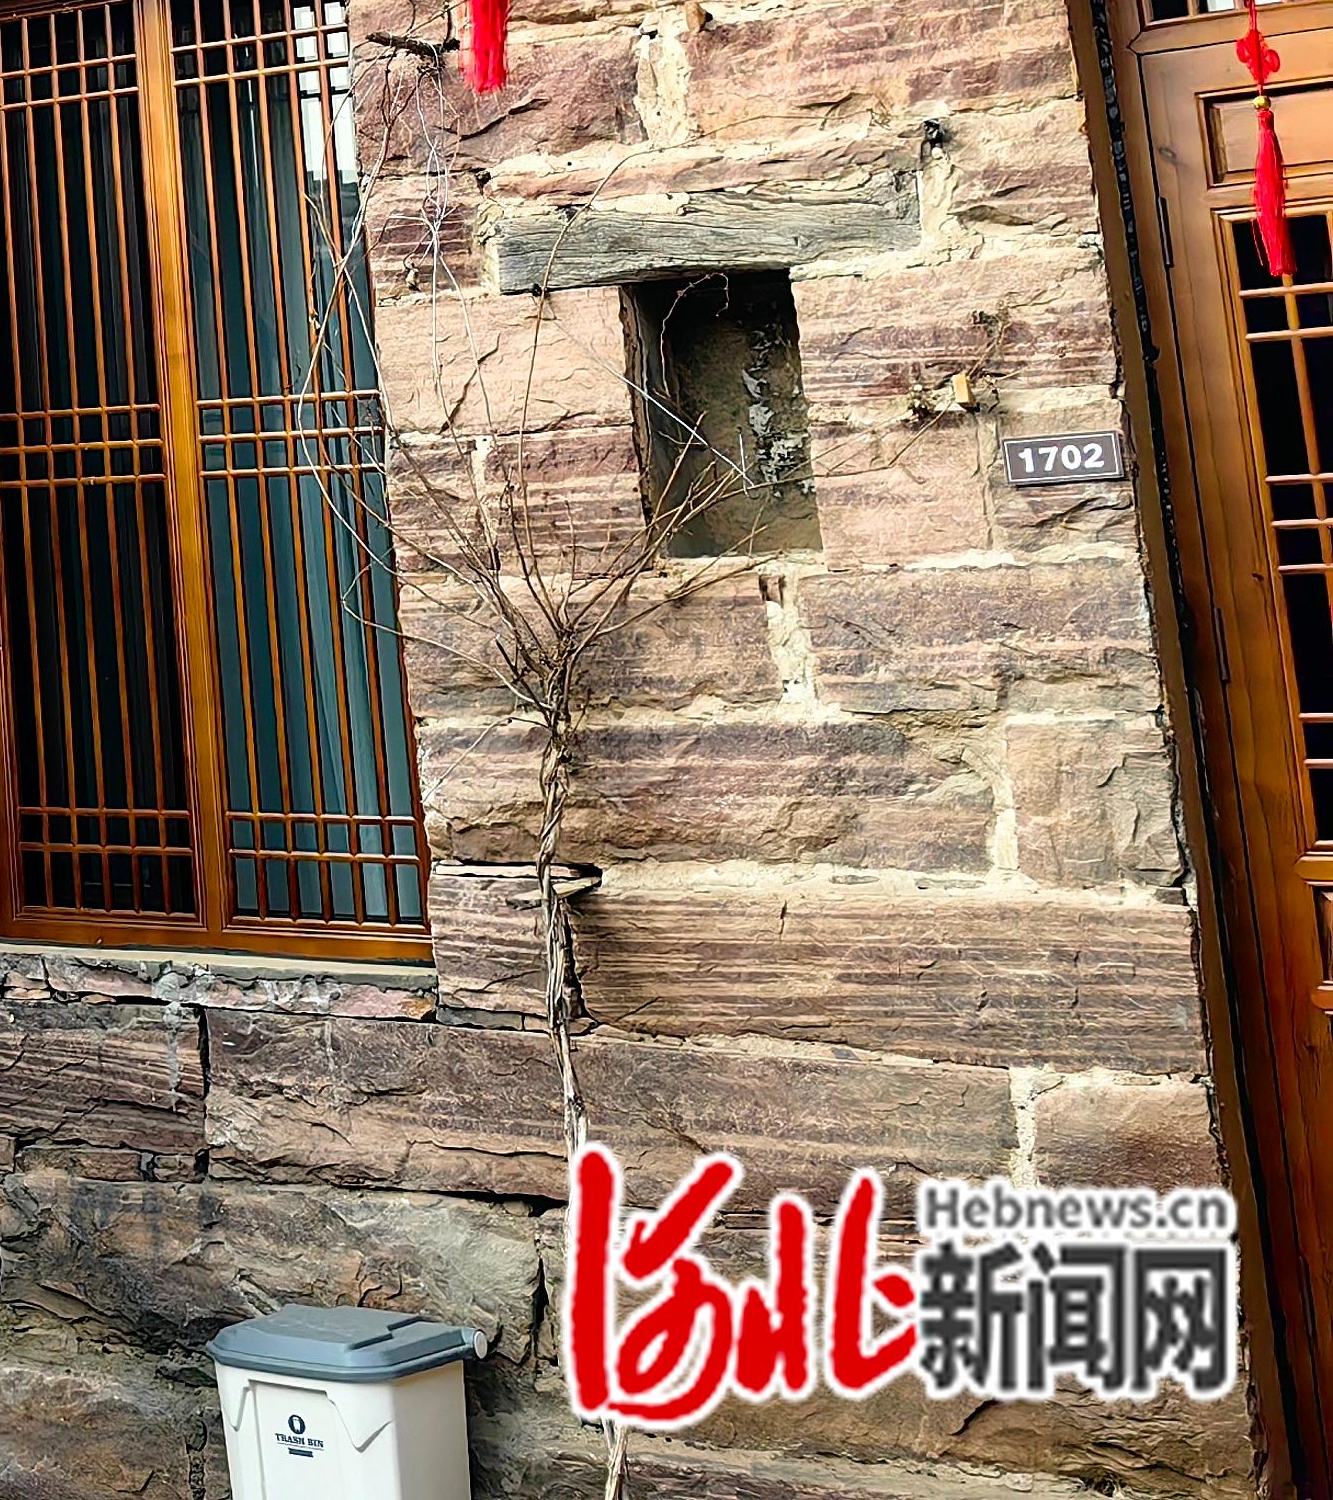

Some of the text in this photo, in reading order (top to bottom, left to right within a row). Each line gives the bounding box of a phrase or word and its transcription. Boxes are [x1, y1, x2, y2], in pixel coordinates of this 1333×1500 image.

[1018, 443, 1105, 473] 1702
[275, 1433, 324, 1448] TRASH BIN
